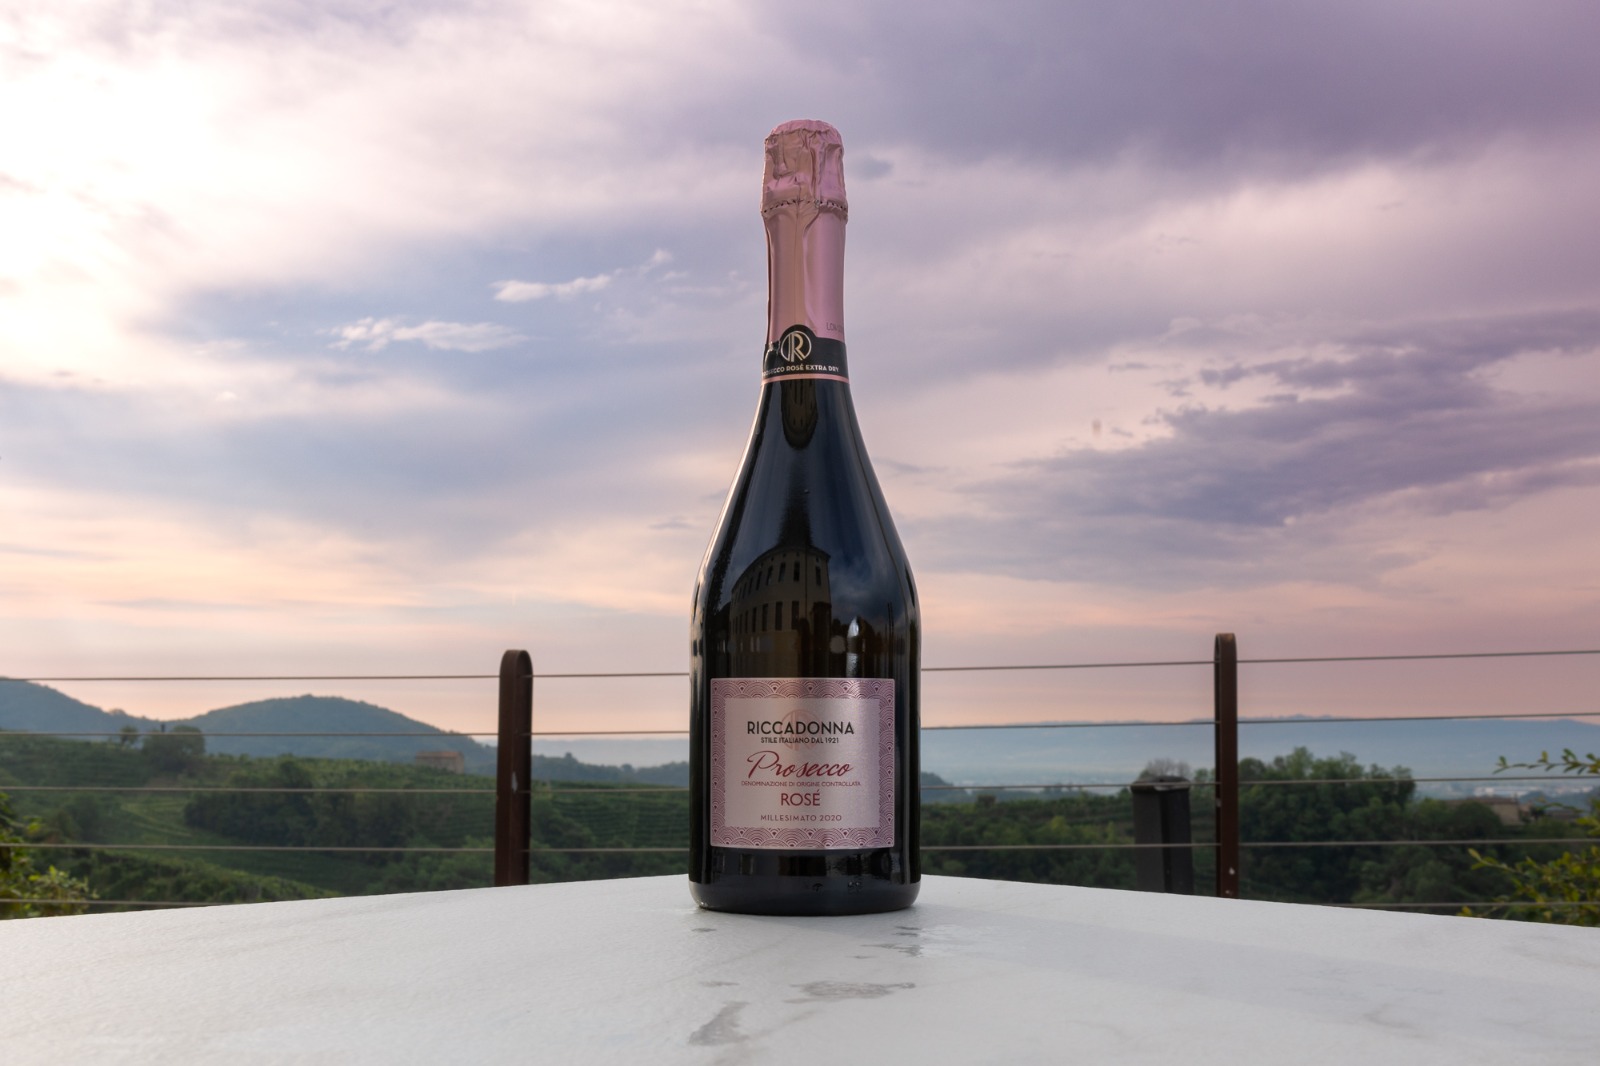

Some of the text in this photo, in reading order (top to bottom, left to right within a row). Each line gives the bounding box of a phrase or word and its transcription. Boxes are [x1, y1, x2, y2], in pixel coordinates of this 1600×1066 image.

[747, 721, 854, 735] RICCADONNA
[747, 750, 853, 778] Prosecco
[780, 789, 820, 806] ROSÉ
